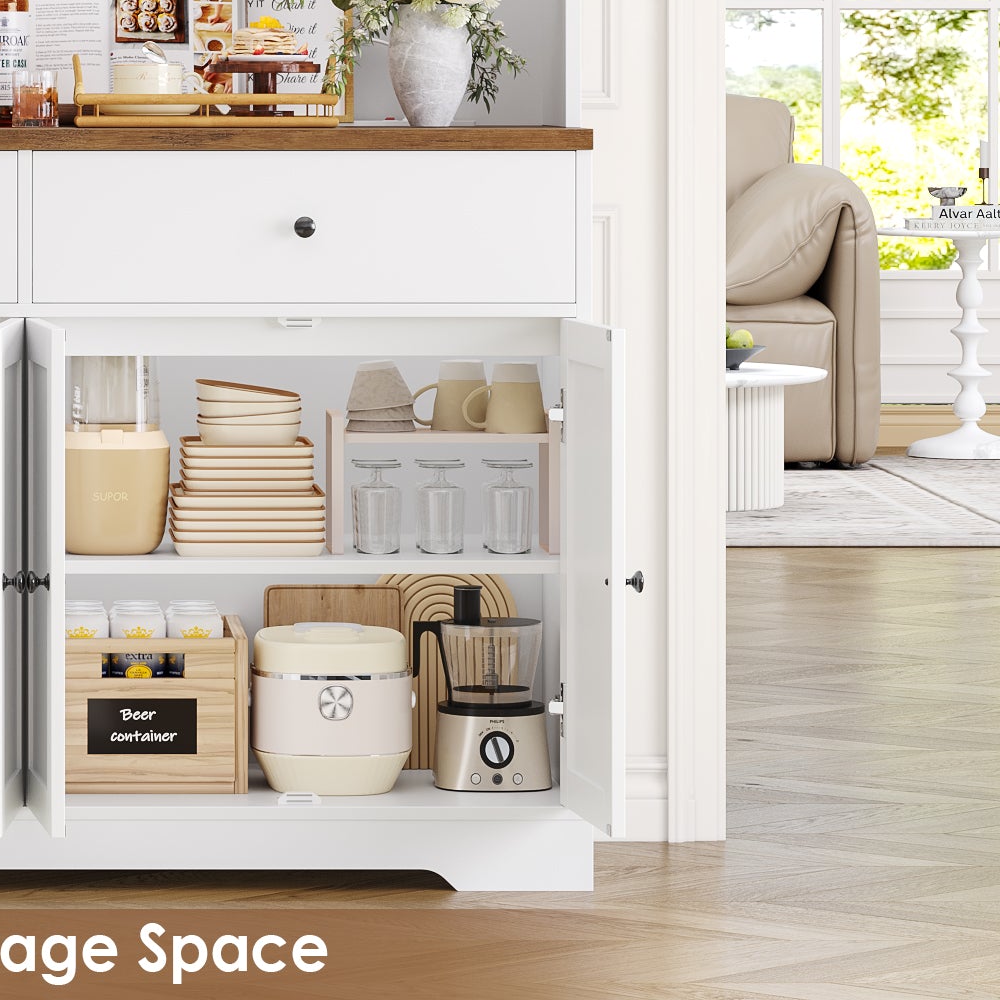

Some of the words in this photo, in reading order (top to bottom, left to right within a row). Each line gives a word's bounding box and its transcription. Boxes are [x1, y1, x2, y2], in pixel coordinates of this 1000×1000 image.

[256, 0, 265, 8] IT
[286, 22, 305, 35] ipe
[308, 22, 318, 35] it
[308, 47, 318, 59] it
[309, 73, 319, 84] it
[939, 208, 973, 219] Alvar
[976, 208, 1000, 219] Aalt
[92, 491, 129, 502] SUPOR
[125, 652, 153, 661] extra
[120, 708, 157, 722] Beer
[110, 729, 178, 743] container
